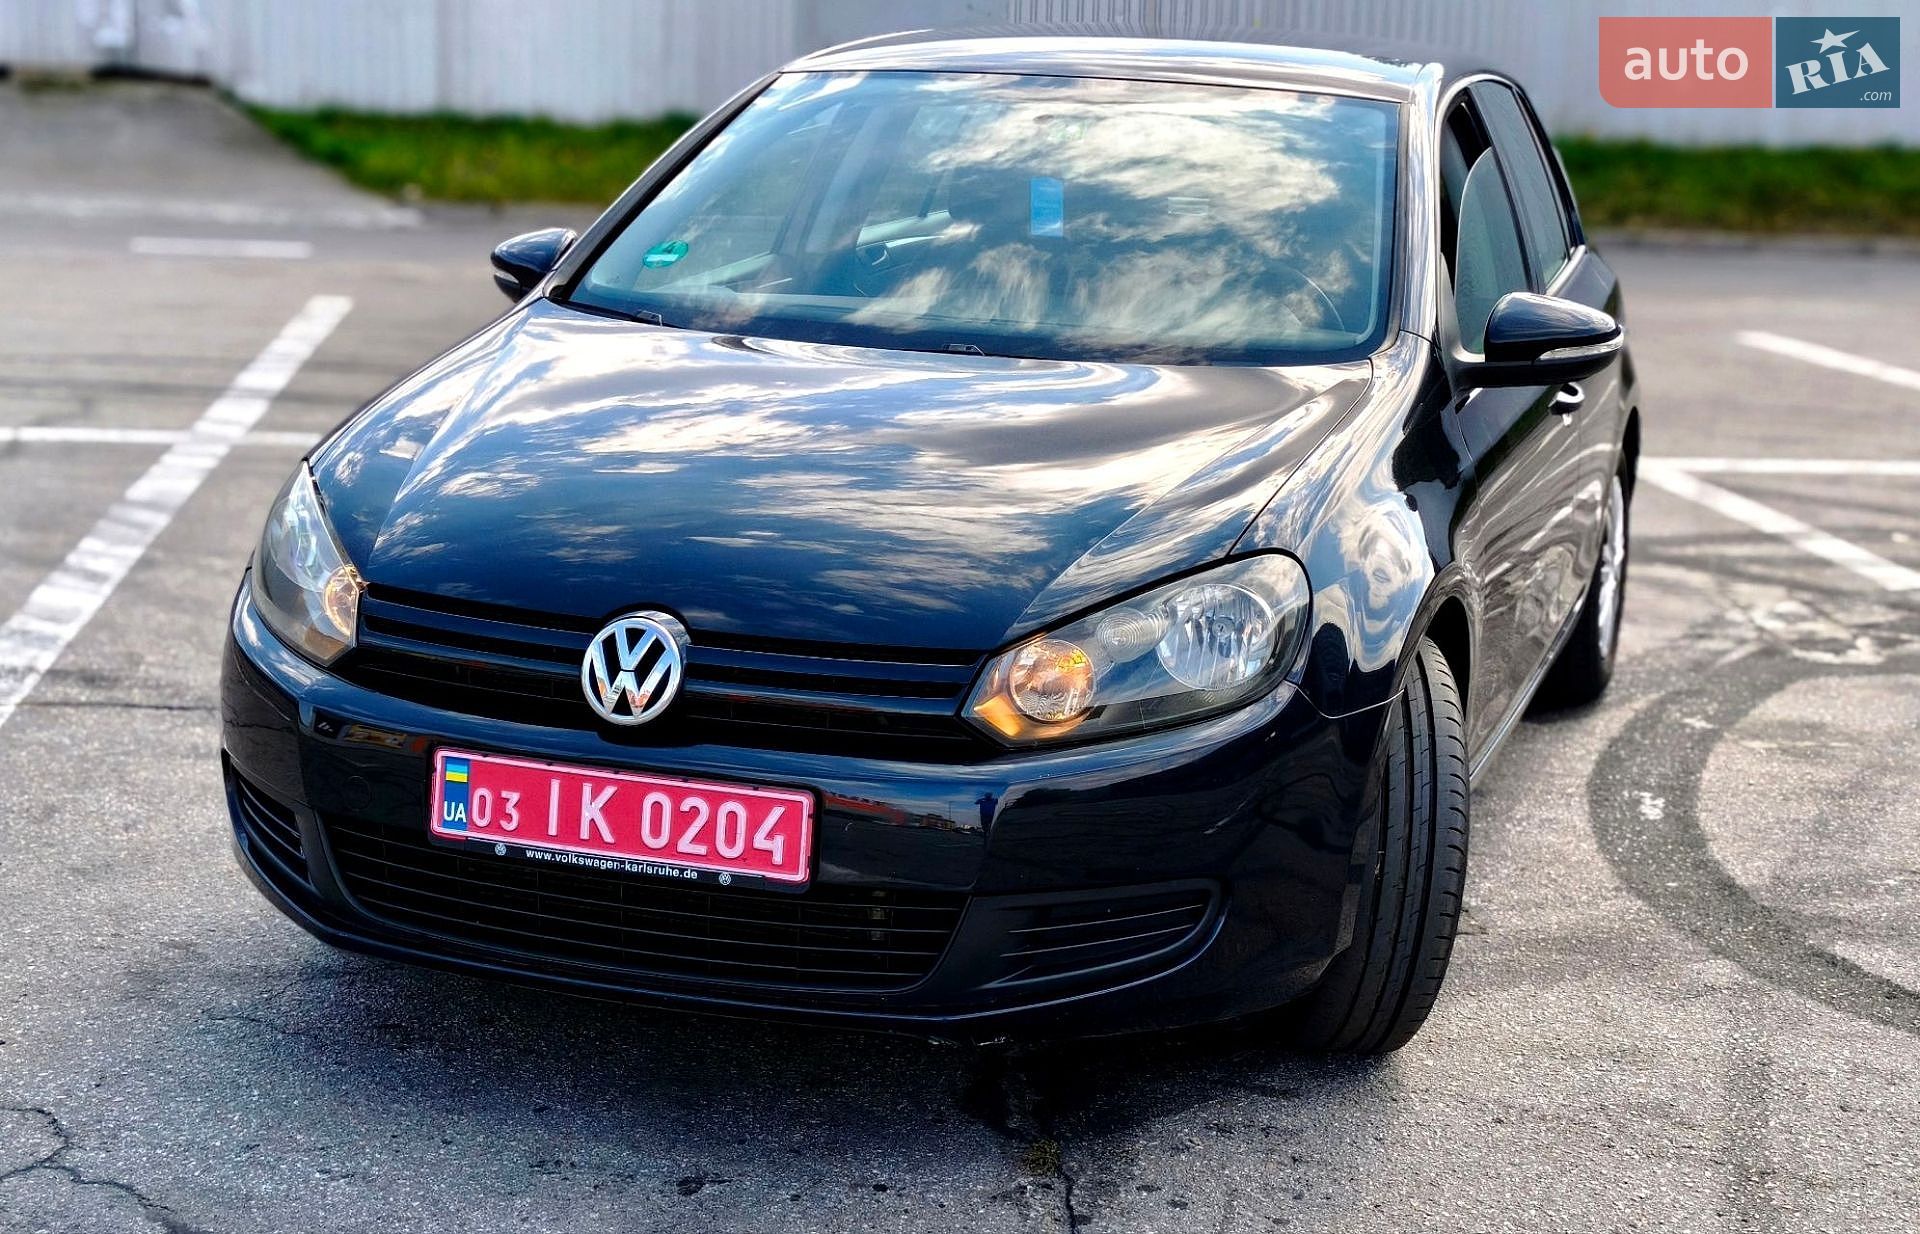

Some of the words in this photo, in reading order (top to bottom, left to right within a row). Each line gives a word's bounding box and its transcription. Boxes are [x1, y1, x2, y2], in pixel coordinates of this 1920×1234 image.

[443, 800, 467, 823] UA
[471, 787, 520, 831] 03
[547, 779, 617, 844] IK
[640, 792, 786, 866] 0204
[525, 849, 698, 879] www.volkswagen-karlsruhe.de
